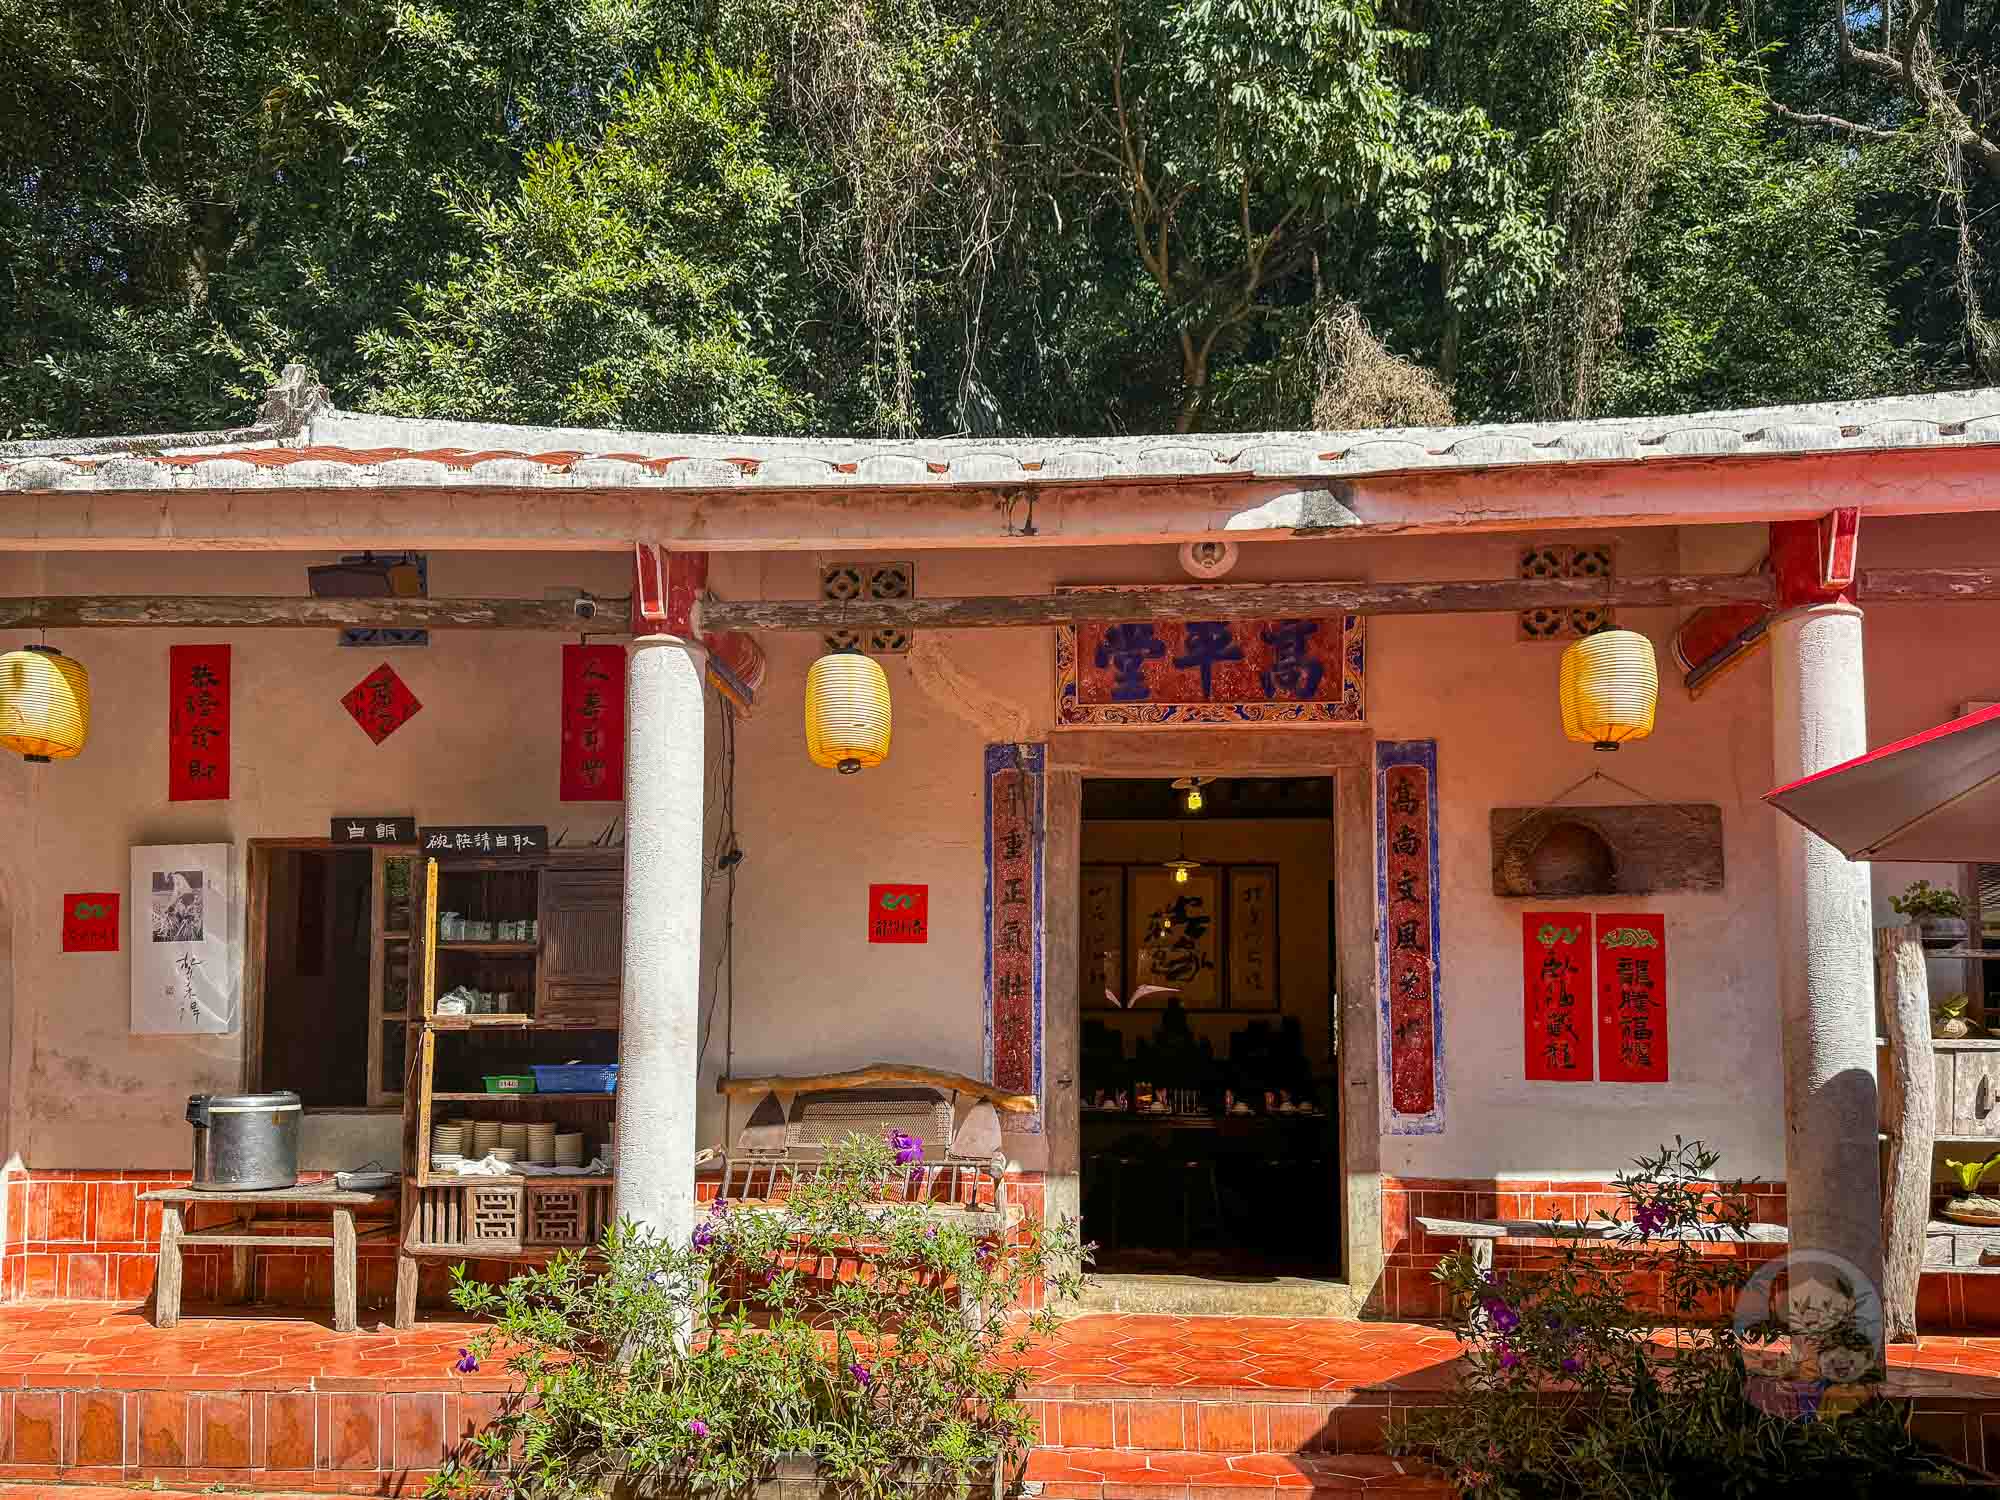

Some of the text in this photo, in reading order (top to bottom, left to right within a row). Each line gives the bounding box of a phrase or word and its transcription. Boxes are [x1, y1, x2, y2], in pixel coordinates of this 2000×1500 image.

[346, 821, 398, 841] 白飯
[426, 832, 537, 852] 碗筷請自取
